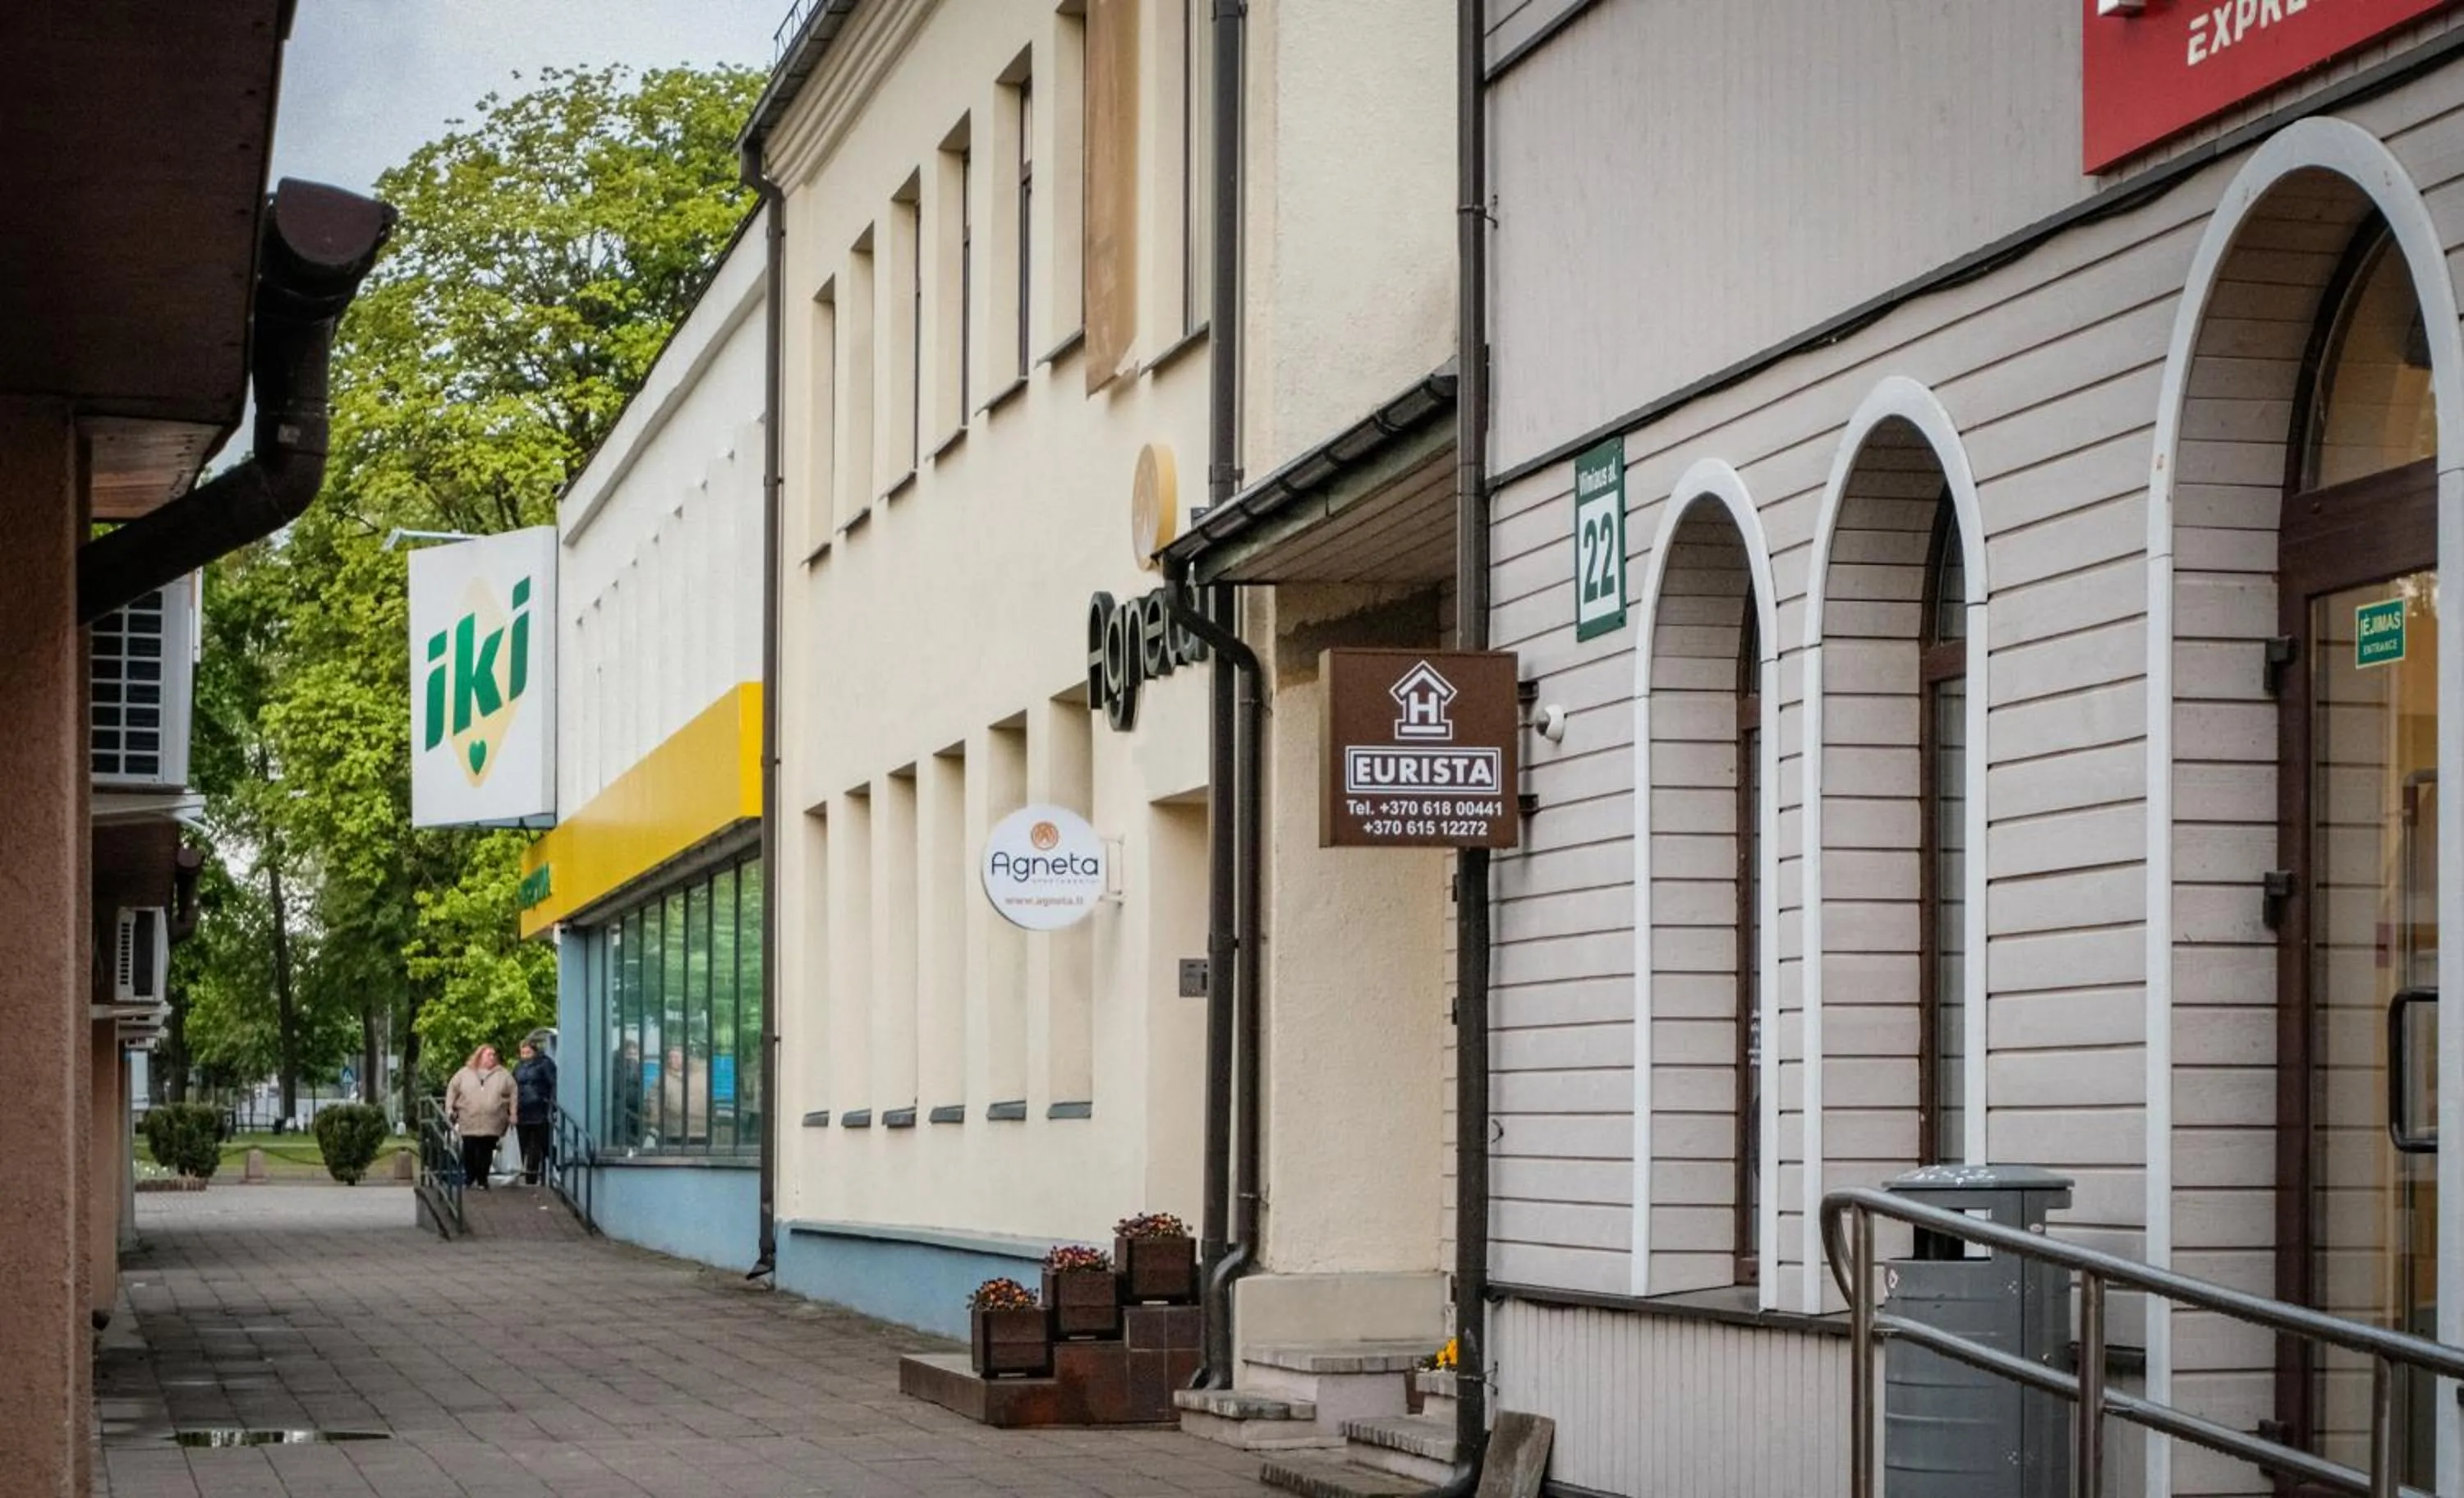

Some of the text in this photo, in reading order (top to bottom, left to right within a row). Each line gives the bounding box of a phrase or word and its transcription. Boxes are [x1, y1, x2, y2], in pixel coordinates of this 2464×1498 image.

[1584, 512, 1615, 604] 22
[425, 575, 531, 751] iki
[1356, 756, 1492, 784] EURISTA
[1346, 800, 1502, 816] Tel. +370 618 00441
[1363, 820, 1487, 835] +370 615 12272
[991, 851, 1098, 883] Agneta
